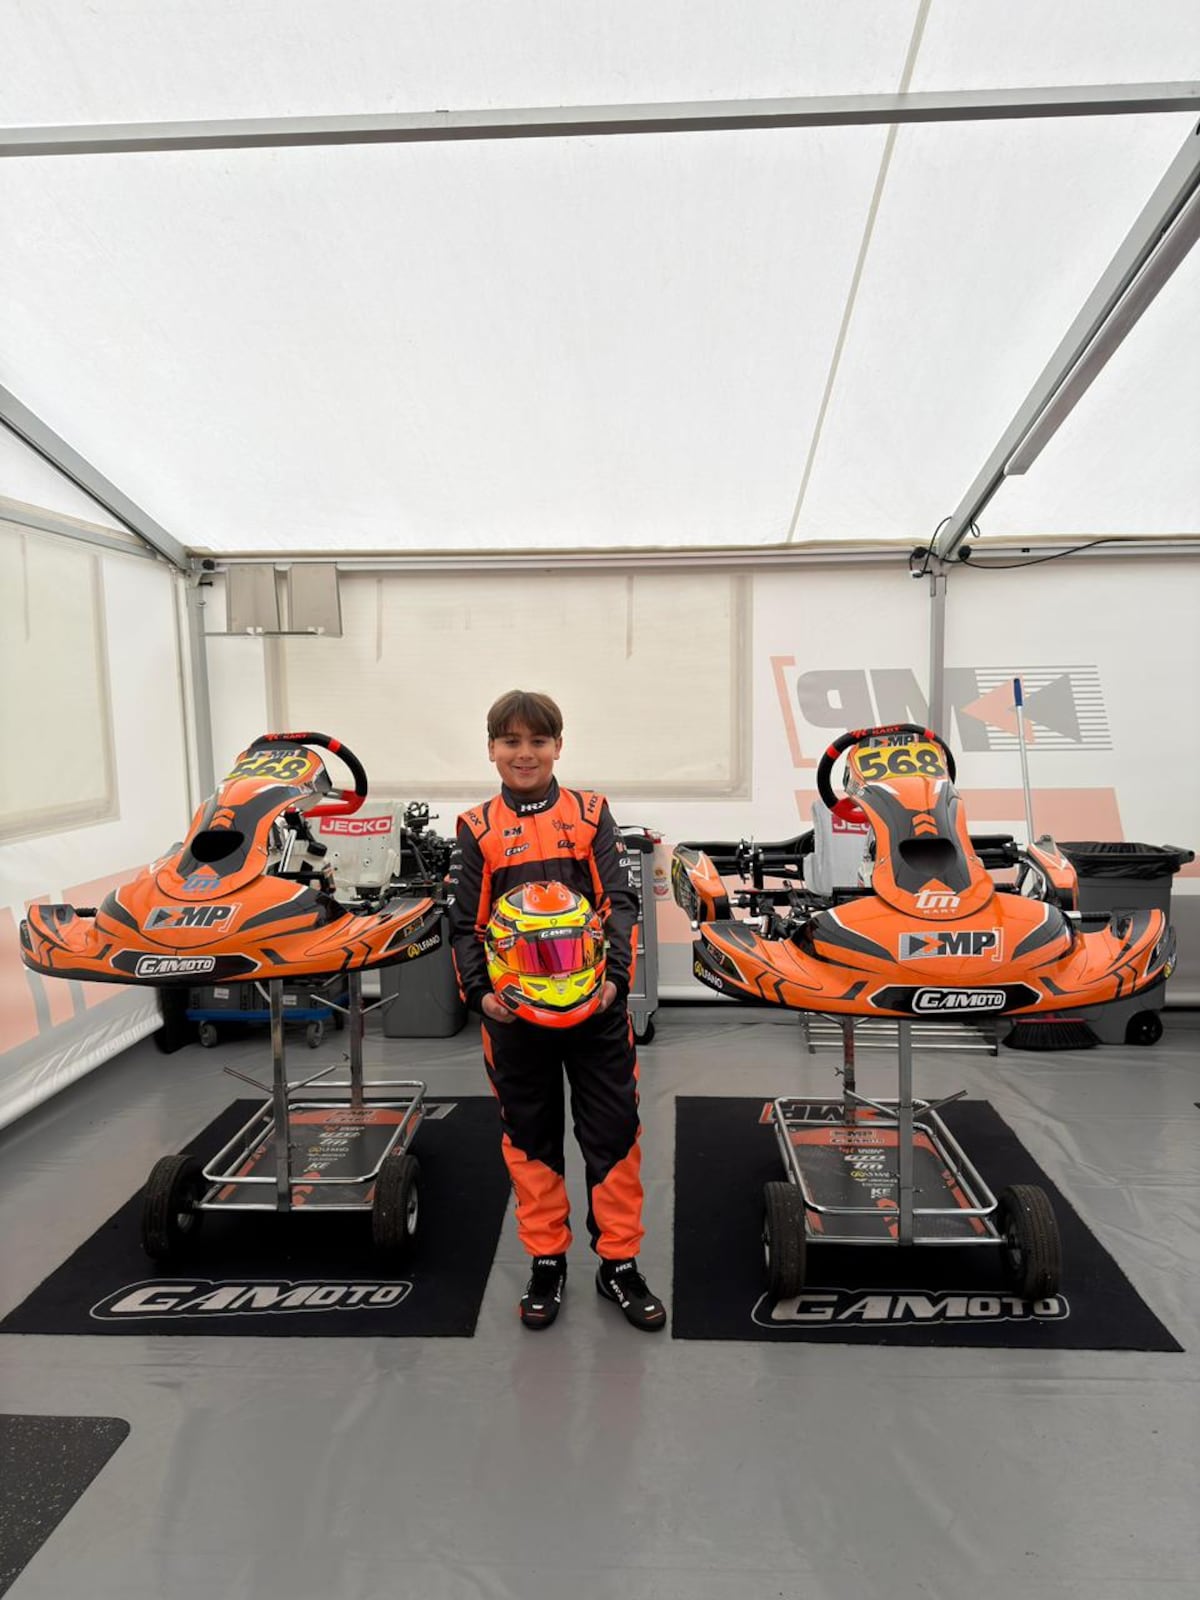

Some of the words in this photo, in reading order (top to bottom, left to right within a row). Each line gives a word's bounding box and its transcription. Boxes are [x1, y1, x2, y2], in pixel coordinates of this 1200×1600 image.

[230, 758, 307, 779] 568
[858, 749, 945, 781] 568
[520, 799, 548, 813] HRX
[321, 818, 391, 834] JECKO
